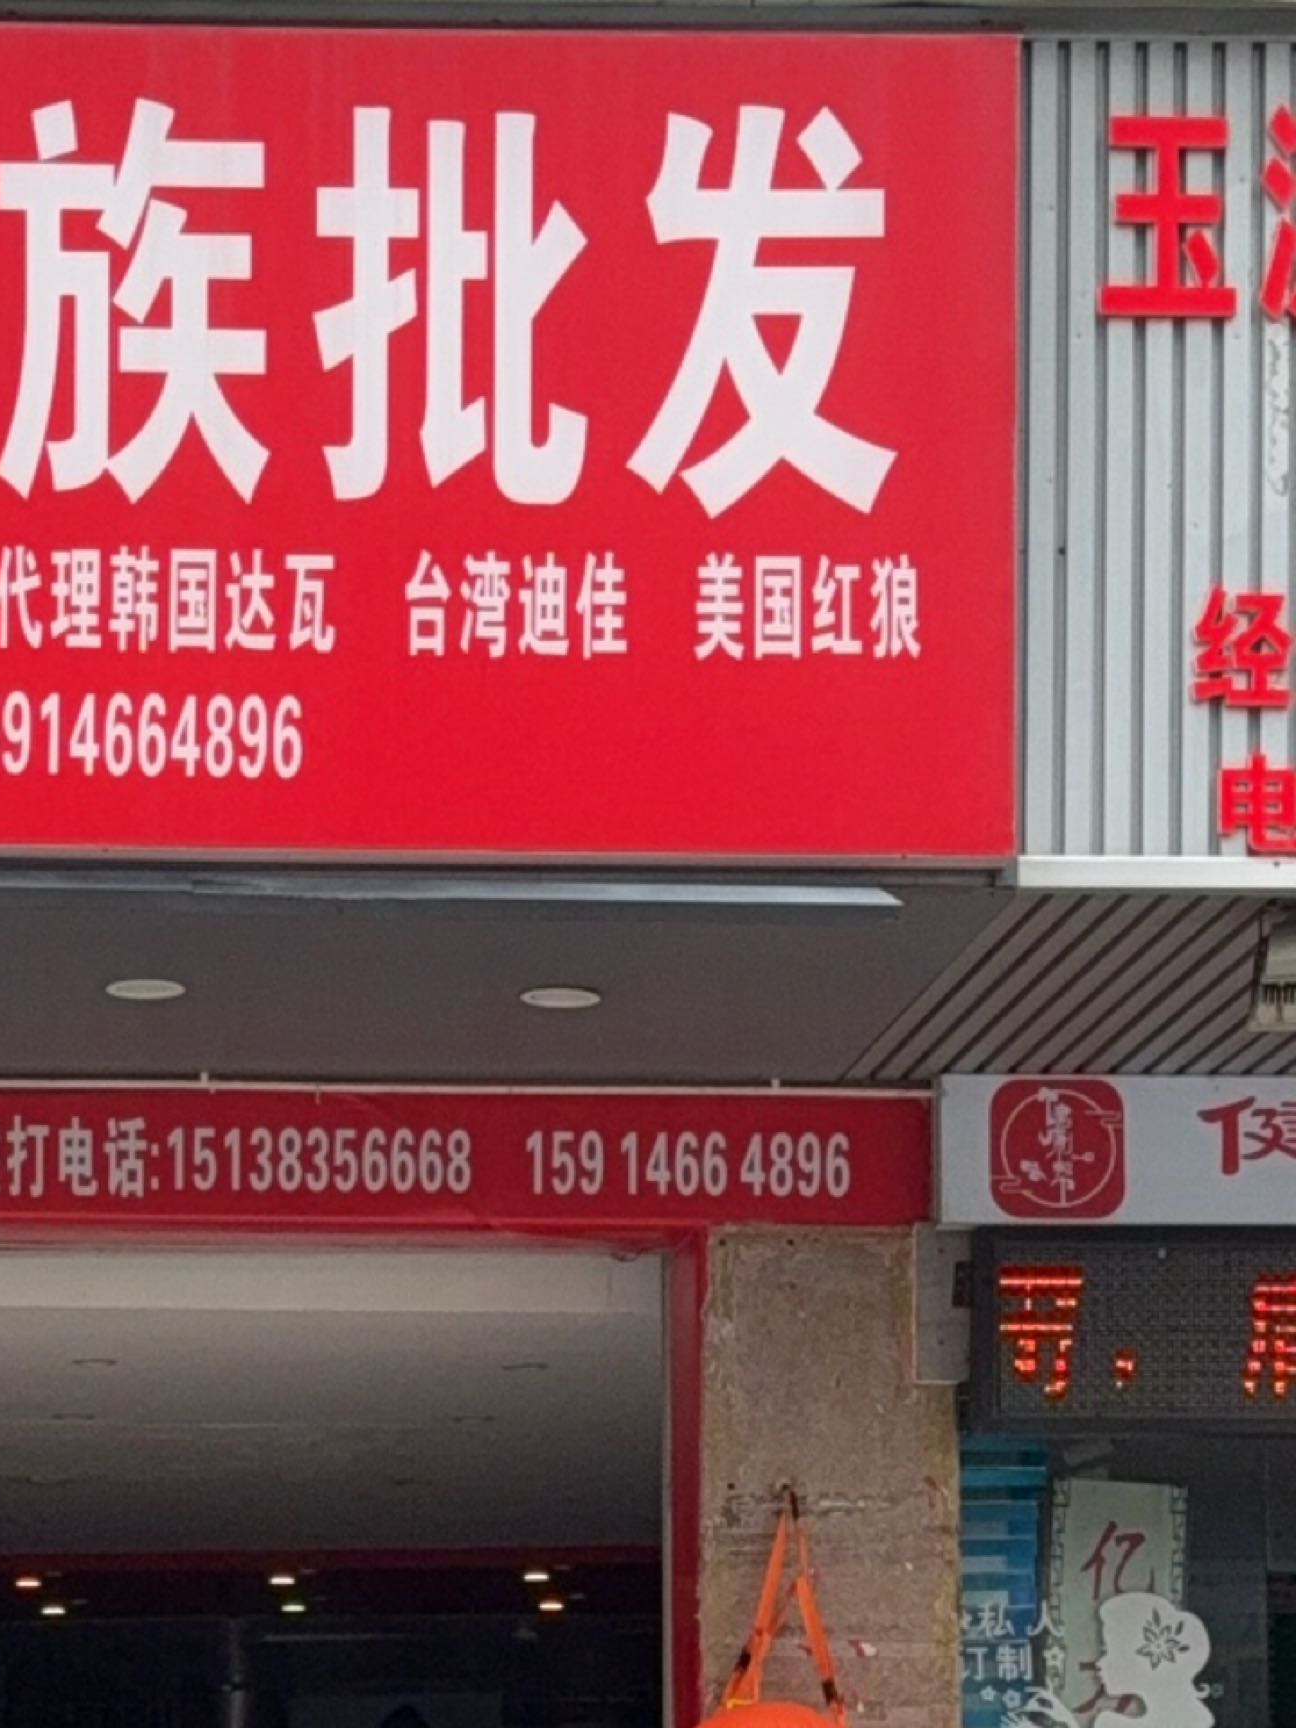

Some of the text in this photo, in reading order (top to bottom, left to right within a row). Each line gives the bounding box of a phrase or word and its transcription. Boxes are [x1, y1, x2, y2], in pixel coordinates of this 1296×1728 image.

[405, 551, 628, 659] 台湾迪佳
[695, 553, 922, 660] 美国红狼
[526, 1130, 605, 1196] 159
[621, 1131, 729, 1197] 1466
[740, 1132, 851, 1198] 4896
